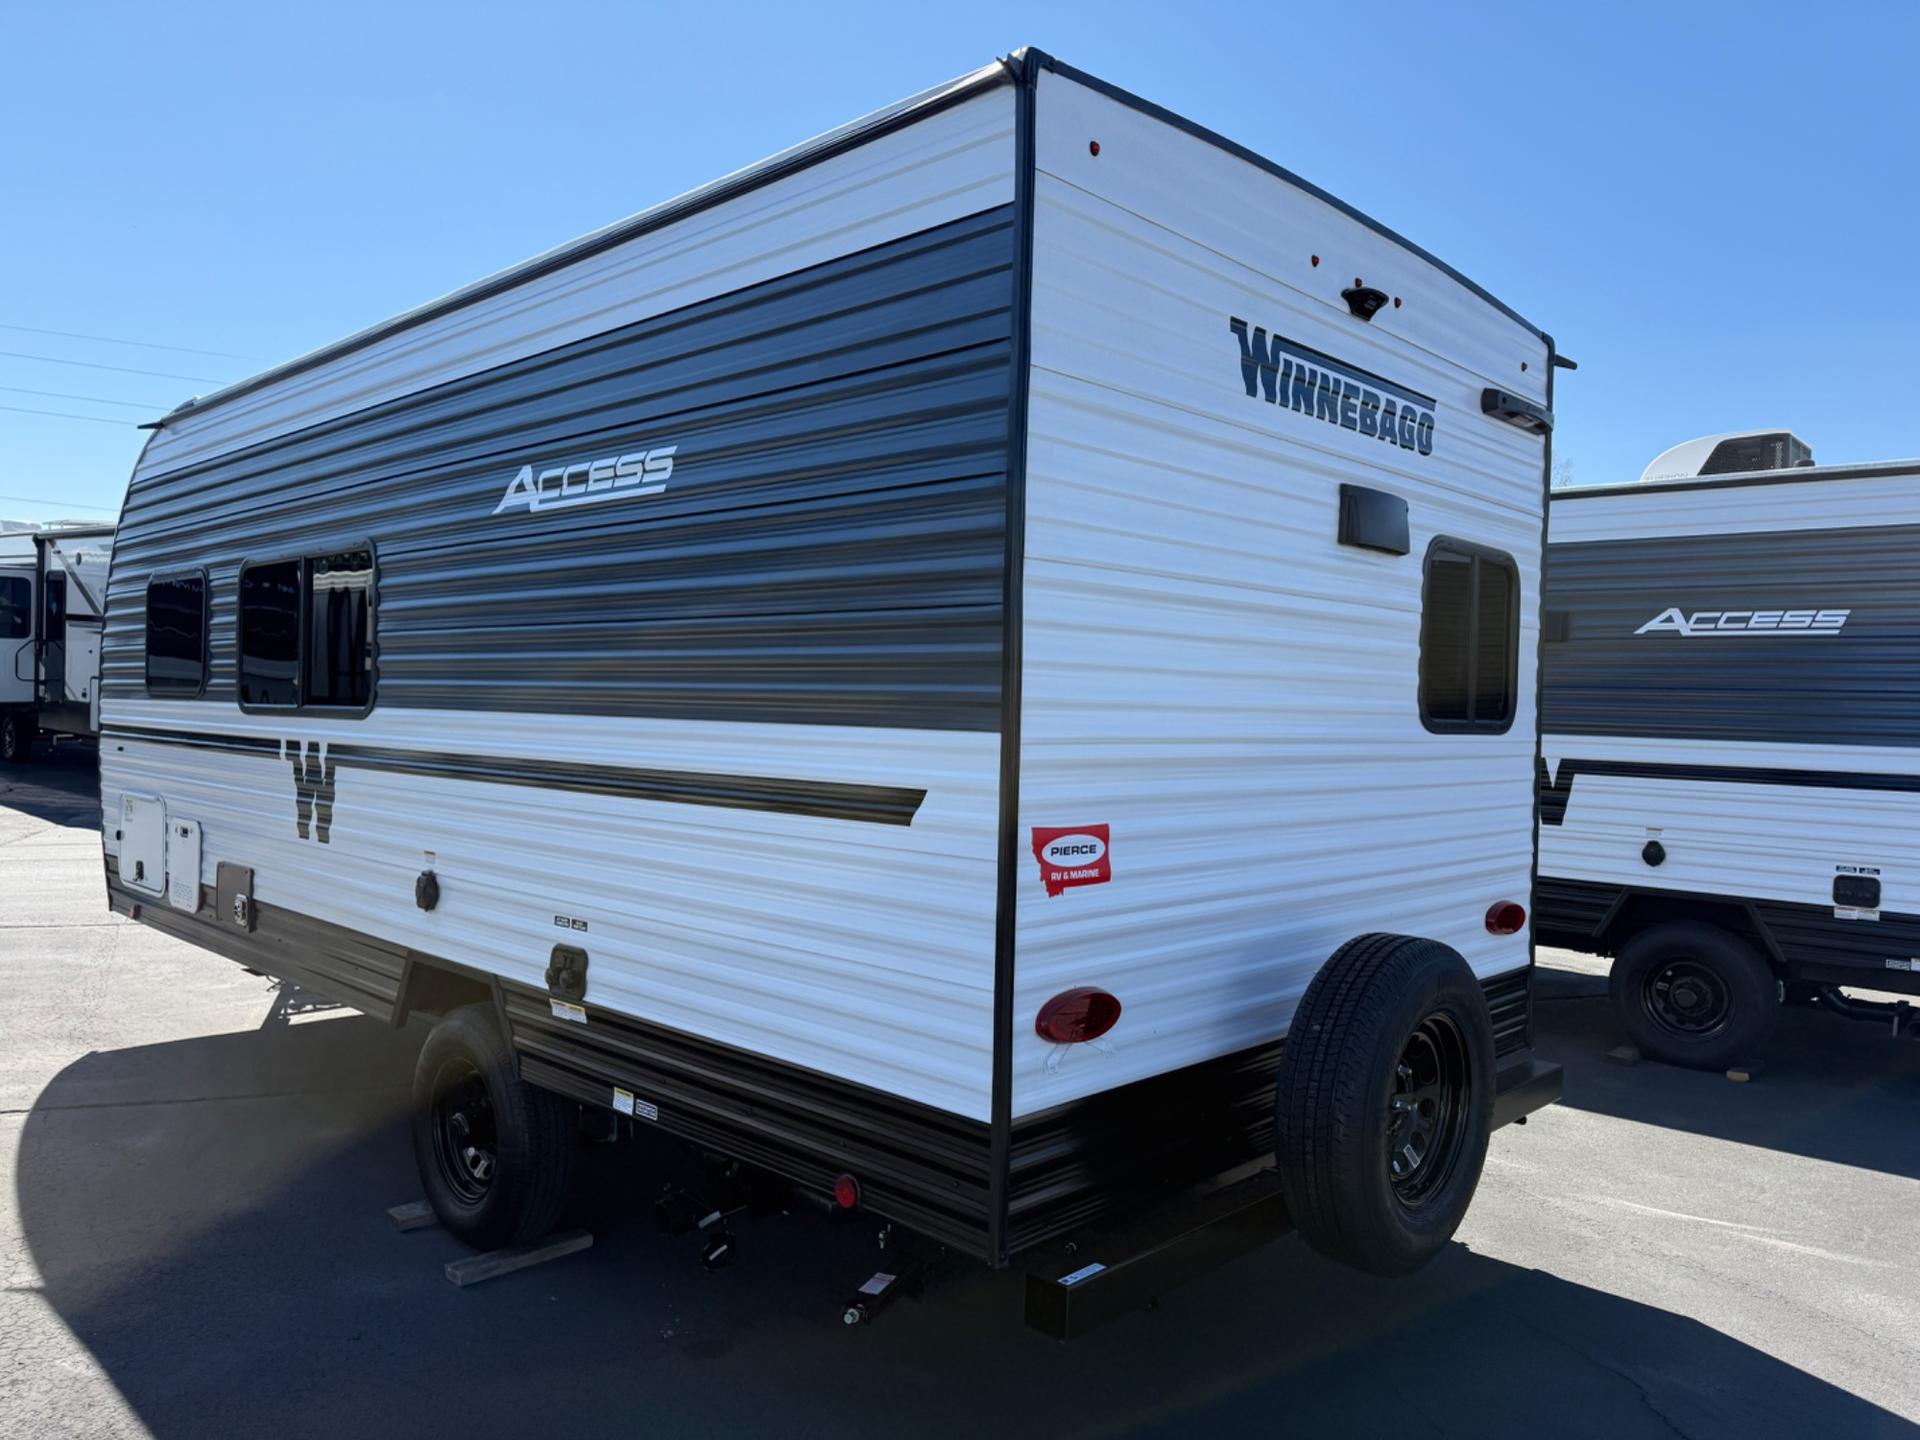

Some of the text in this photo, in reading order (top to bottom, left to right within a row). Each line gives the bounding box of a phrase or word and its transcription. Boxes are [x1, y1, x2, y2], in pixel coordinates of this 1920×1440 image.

[1230, 316, 1437, 456] WINNEBAGO
[491, 445, 678, 514] ACCESS
[1633, 607, 1851, 636] ACCESS
[1050, 844, 1097, 856] PIERCE
[1051, 871, 1062, 881] RV
[1070, 868, 1100, 880] MARINE
